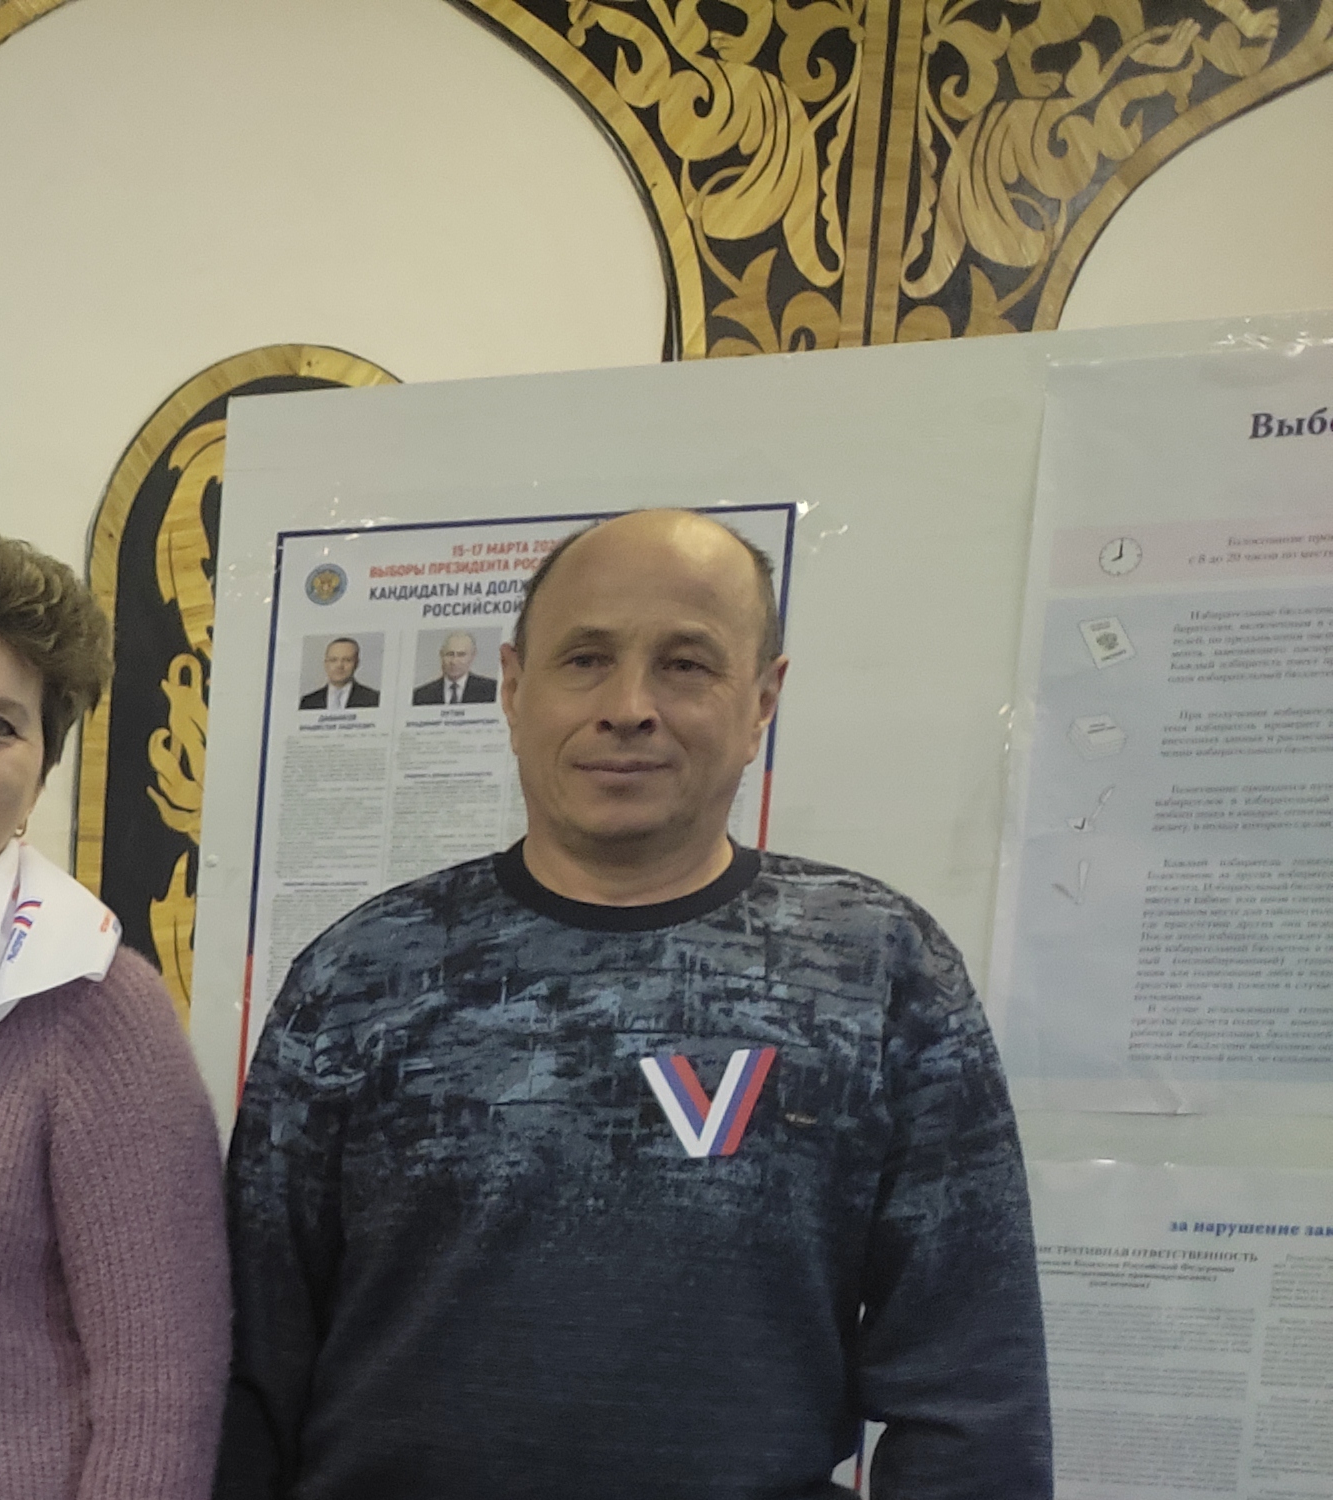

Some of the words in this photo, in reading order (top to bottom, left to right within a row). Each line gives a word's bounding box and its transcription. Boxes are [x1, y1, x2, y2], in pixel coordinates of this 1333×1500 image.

[1249, 407, 1333, 439] Выб
[486, 541, 529, 555] МАРТА
[369, 563, 425, 578] ВЫБОРЫ
[428, 558, 509, 575] ПРЕЗИДЕНТА
[369, 582, 459, 601] КАНДИДАТЫ
[463, 580, 483, 595] НА
[485, 578, 529, 597] ДОЛЖ
[1193, 1221, 1300, 1237] нарушение
[1304, 1226, 1333, 1236] зак
